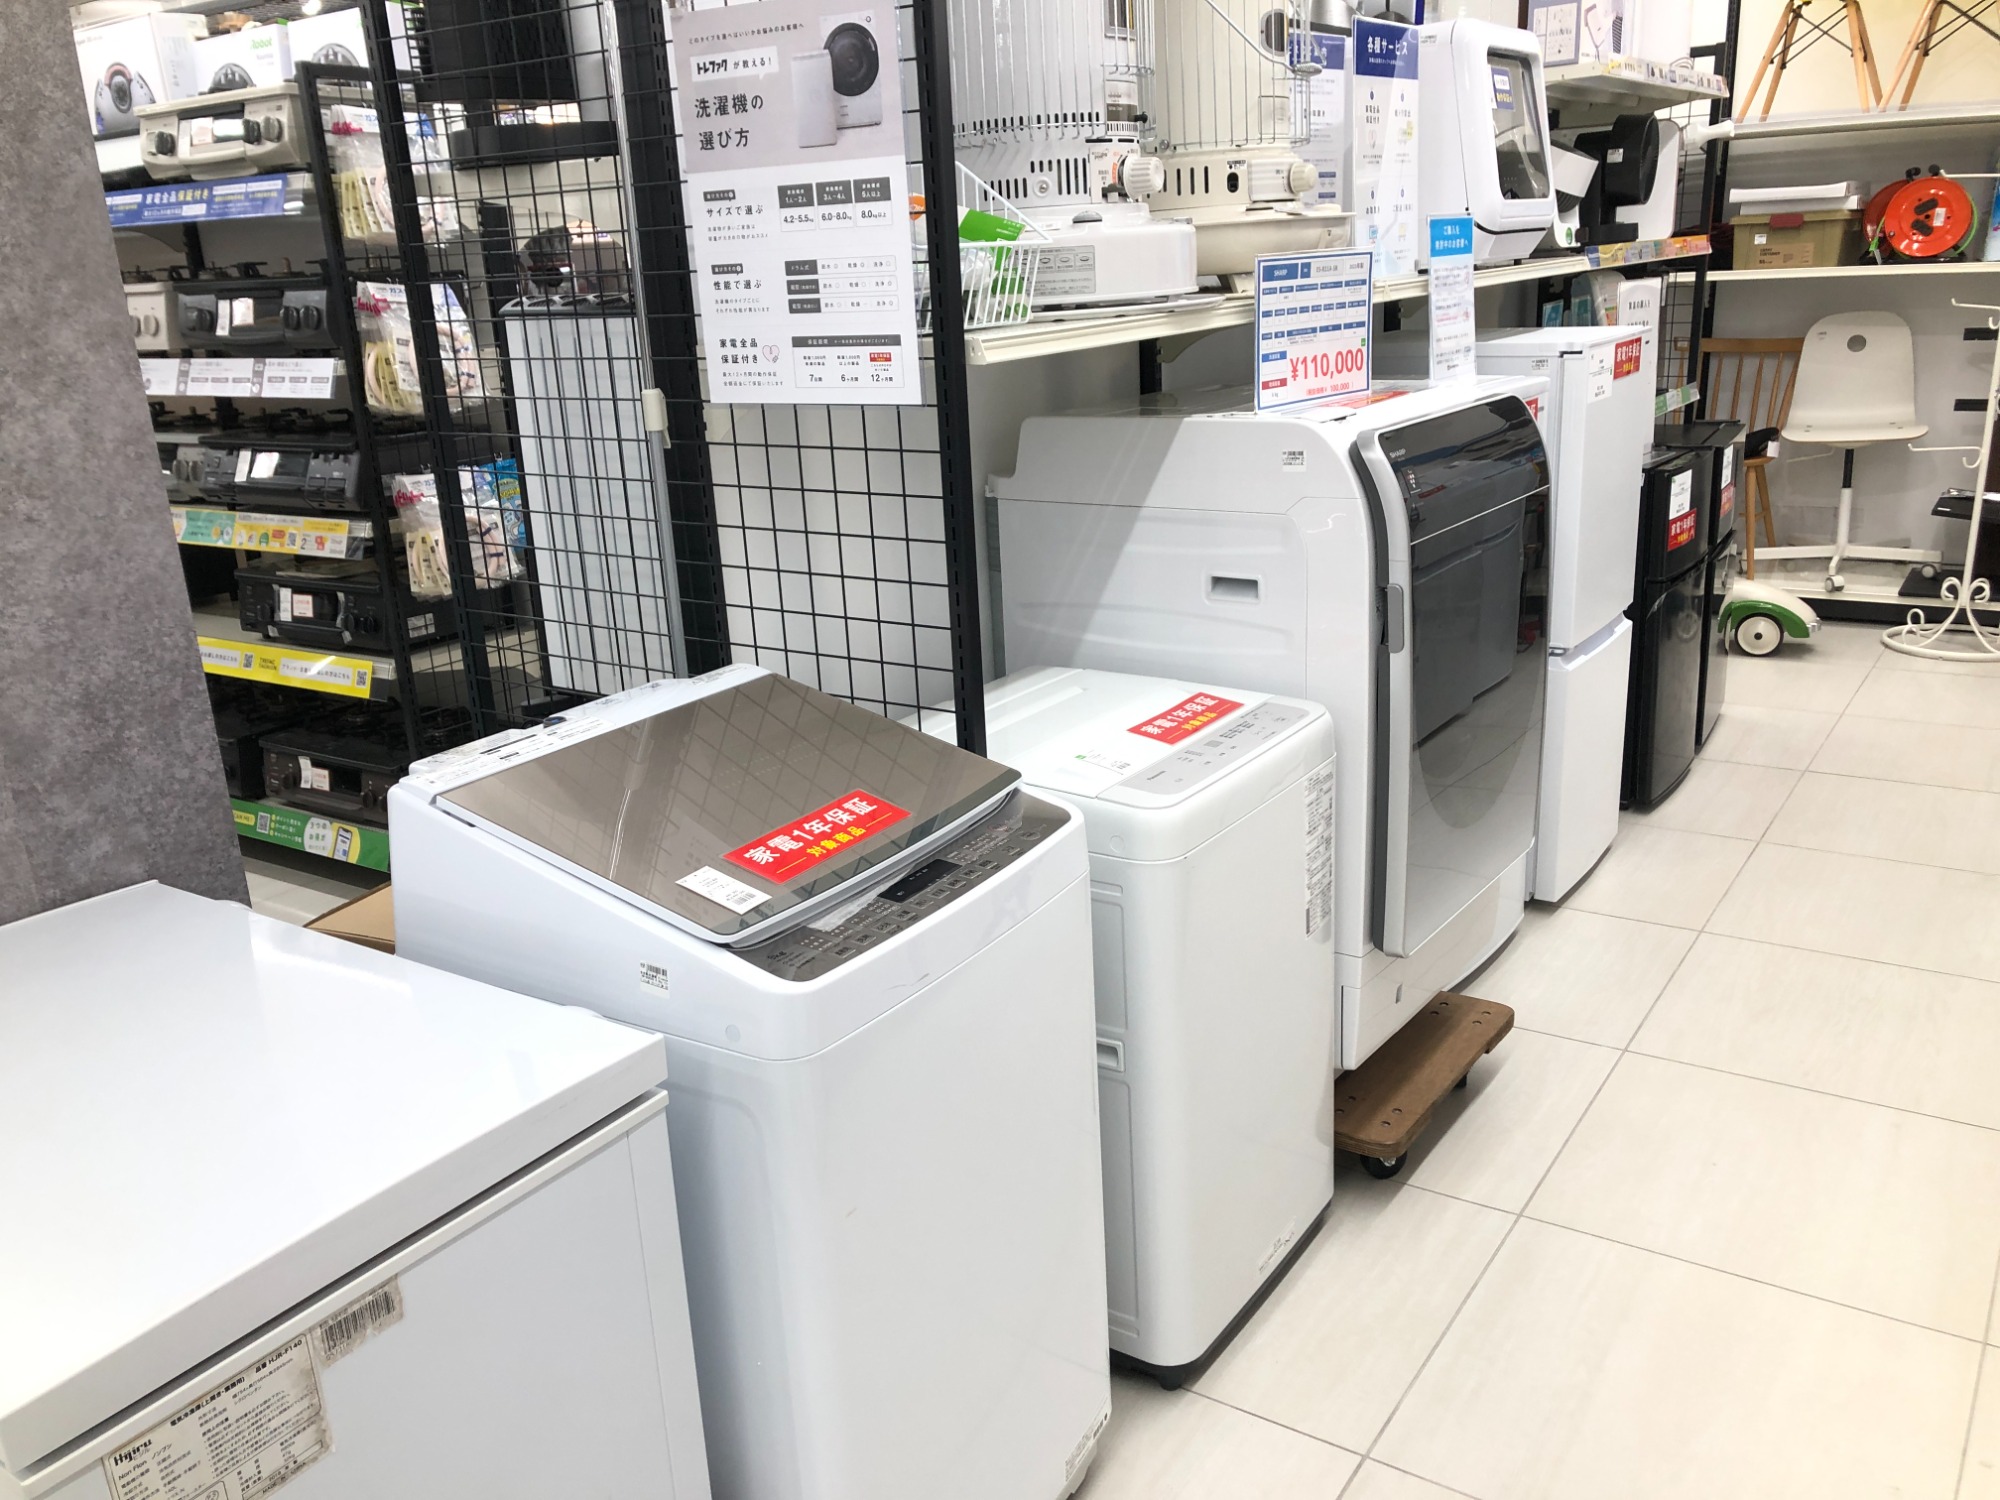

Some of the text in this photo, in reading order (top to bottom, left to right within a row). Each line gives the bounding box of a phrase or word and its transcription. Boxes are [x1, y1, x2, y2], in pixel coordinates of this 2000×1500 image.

[1367, 35, 1408, 56] 各種サービス
[694, 94, 764, 119] 洗濯機の
[698, 127, 750, 151] 選び方
[706, 204, 764, 218] サイズで選ぶ
[1273, 269, 1288, 277] SHARP
[713, 279, 762, 291] 性能で選ぶ
[719, 337, 758, 348] 家電全品
[1617, 342, 1640, 362] 家電1年保証
[721, 353, 758, 364] 保証付き
[1289, 348, 1364, 382] ¥110,000
[1671, 513, 1695, 537] 家電1年保証
[1139, 695, 1220, 735] 家電1年保証
[1181, 711, 1217, 731] 対象商品
[743, 797, 878, 865] 家電1年保証
[806, 826, 867, 858] 対象商品
[255, 1361, 267, 1374] 品番
[268, 1339, 302, 1365] HJR-F140
[113, 1438, 152, 1466] Hijiru
[118, 1469, 132, 1480] Non
[133, 1460, 147, 1471] Flon
